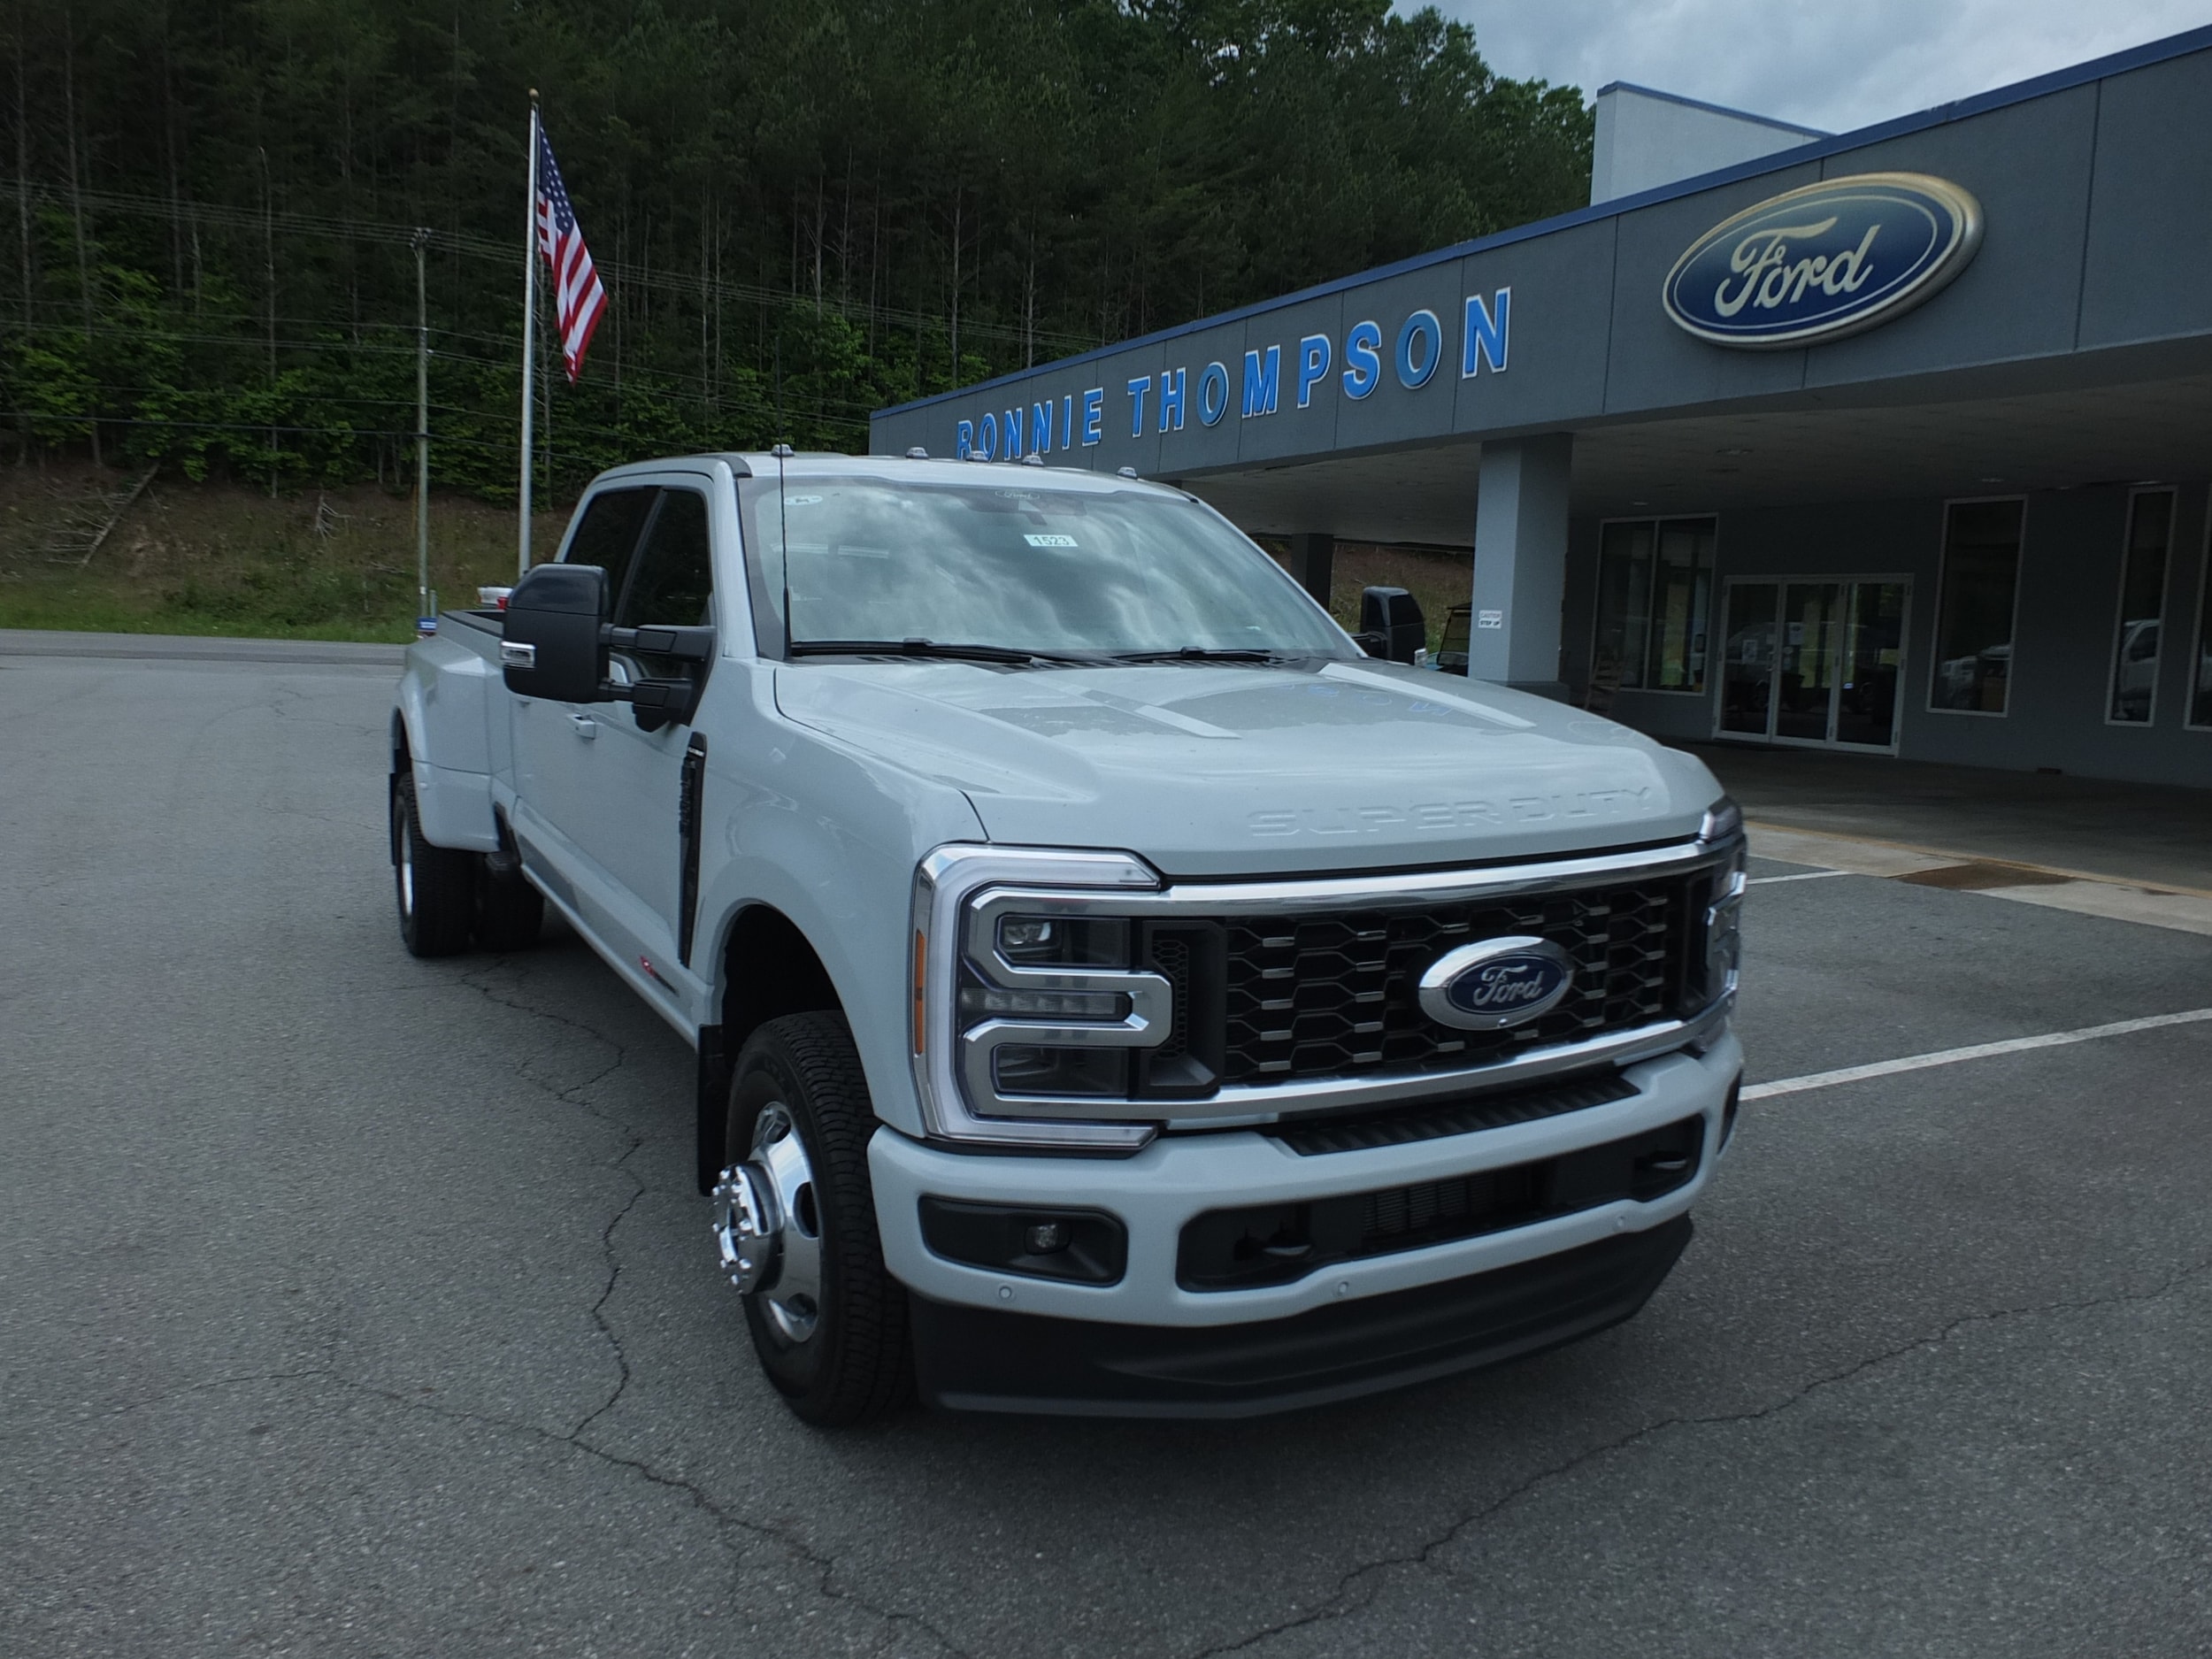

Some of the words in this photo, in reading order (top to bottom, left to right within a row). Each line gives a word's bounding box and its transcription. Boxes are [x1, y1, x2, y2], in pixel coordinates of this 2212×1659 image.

[1714, 216, 1881, 318] Ford
[956, 387, 1103, 464] RONNIE
[1127, 287, 1511, 438] THOMPSON
[1033, 535, 1070, 546] 1523
[1248, 801, 1503, 836] SUPER
[1508, 787, 1651, 822] DUTY
[1472, 964, 1545, 1006] Ford
